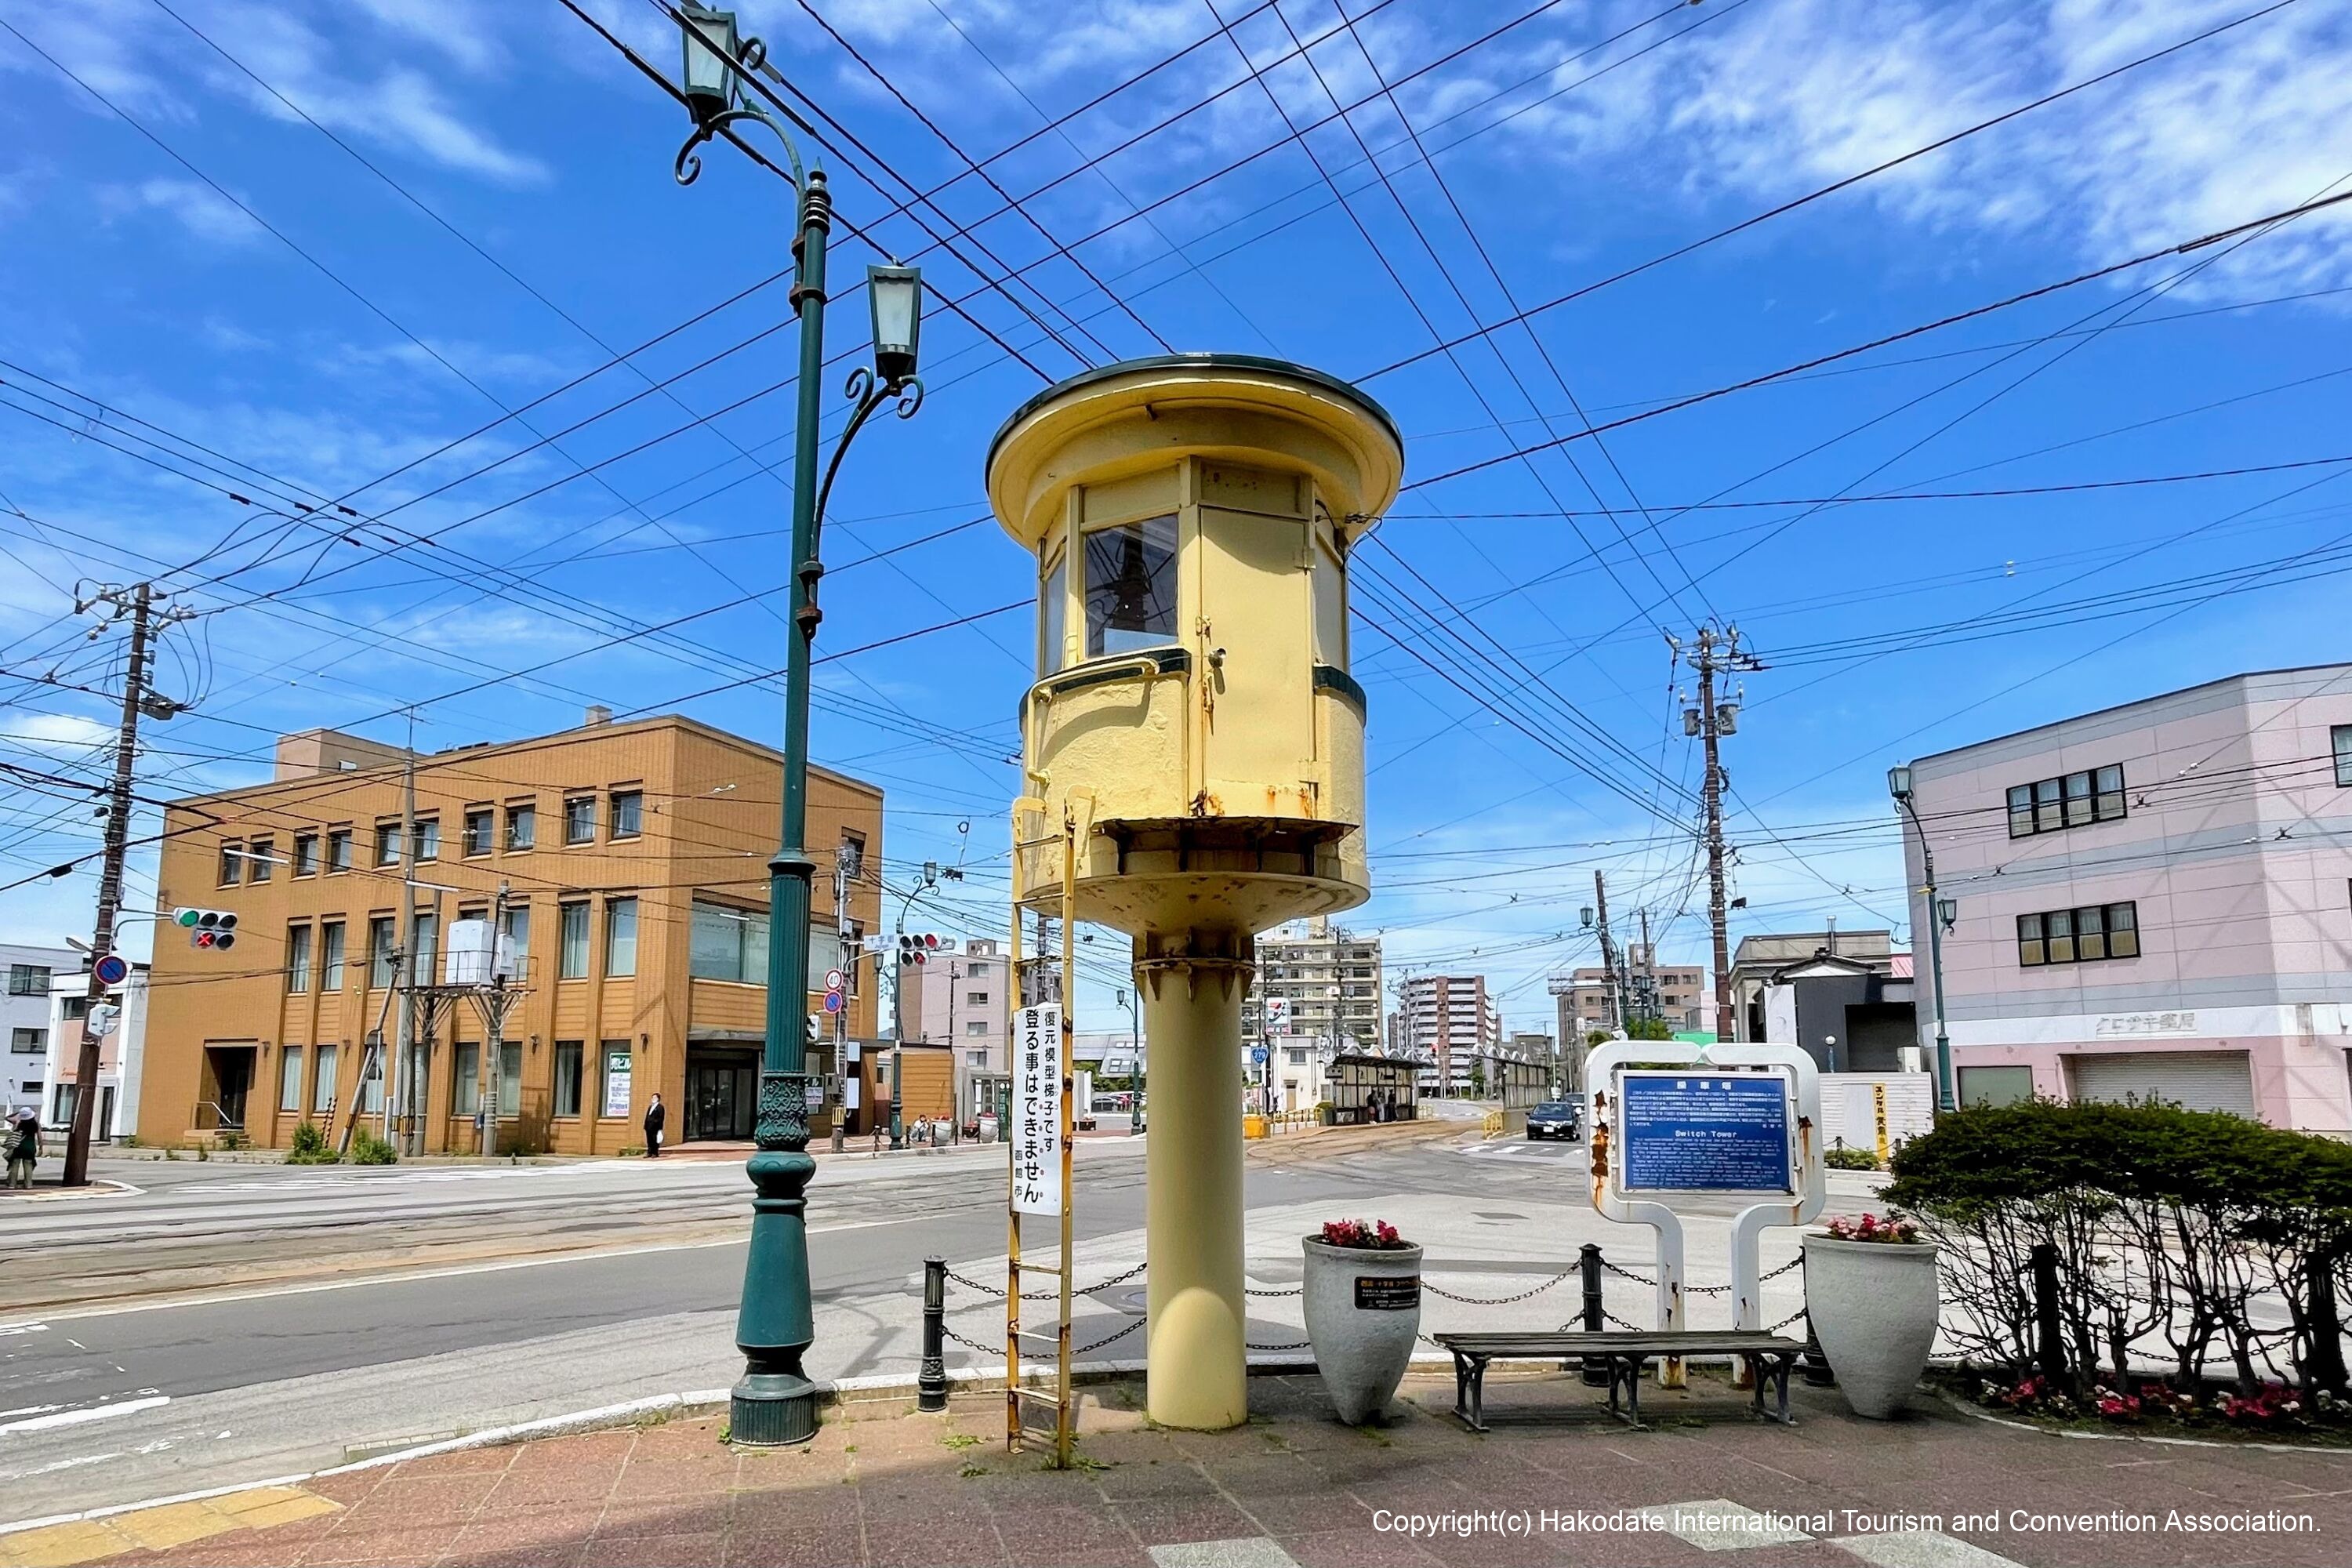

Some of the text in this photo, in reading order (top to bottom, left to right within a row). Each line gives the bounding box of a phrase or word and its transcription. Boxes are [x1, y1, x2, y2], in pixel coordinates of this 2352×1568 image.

[829, 975, 839, 985] 40
[1024, 1008, 1040, 1203] 登る事はできません
[1044, 1011, 1055, 1152] 復元模型梯子です
[1014, 1149, 1023, 1198] 函館市
